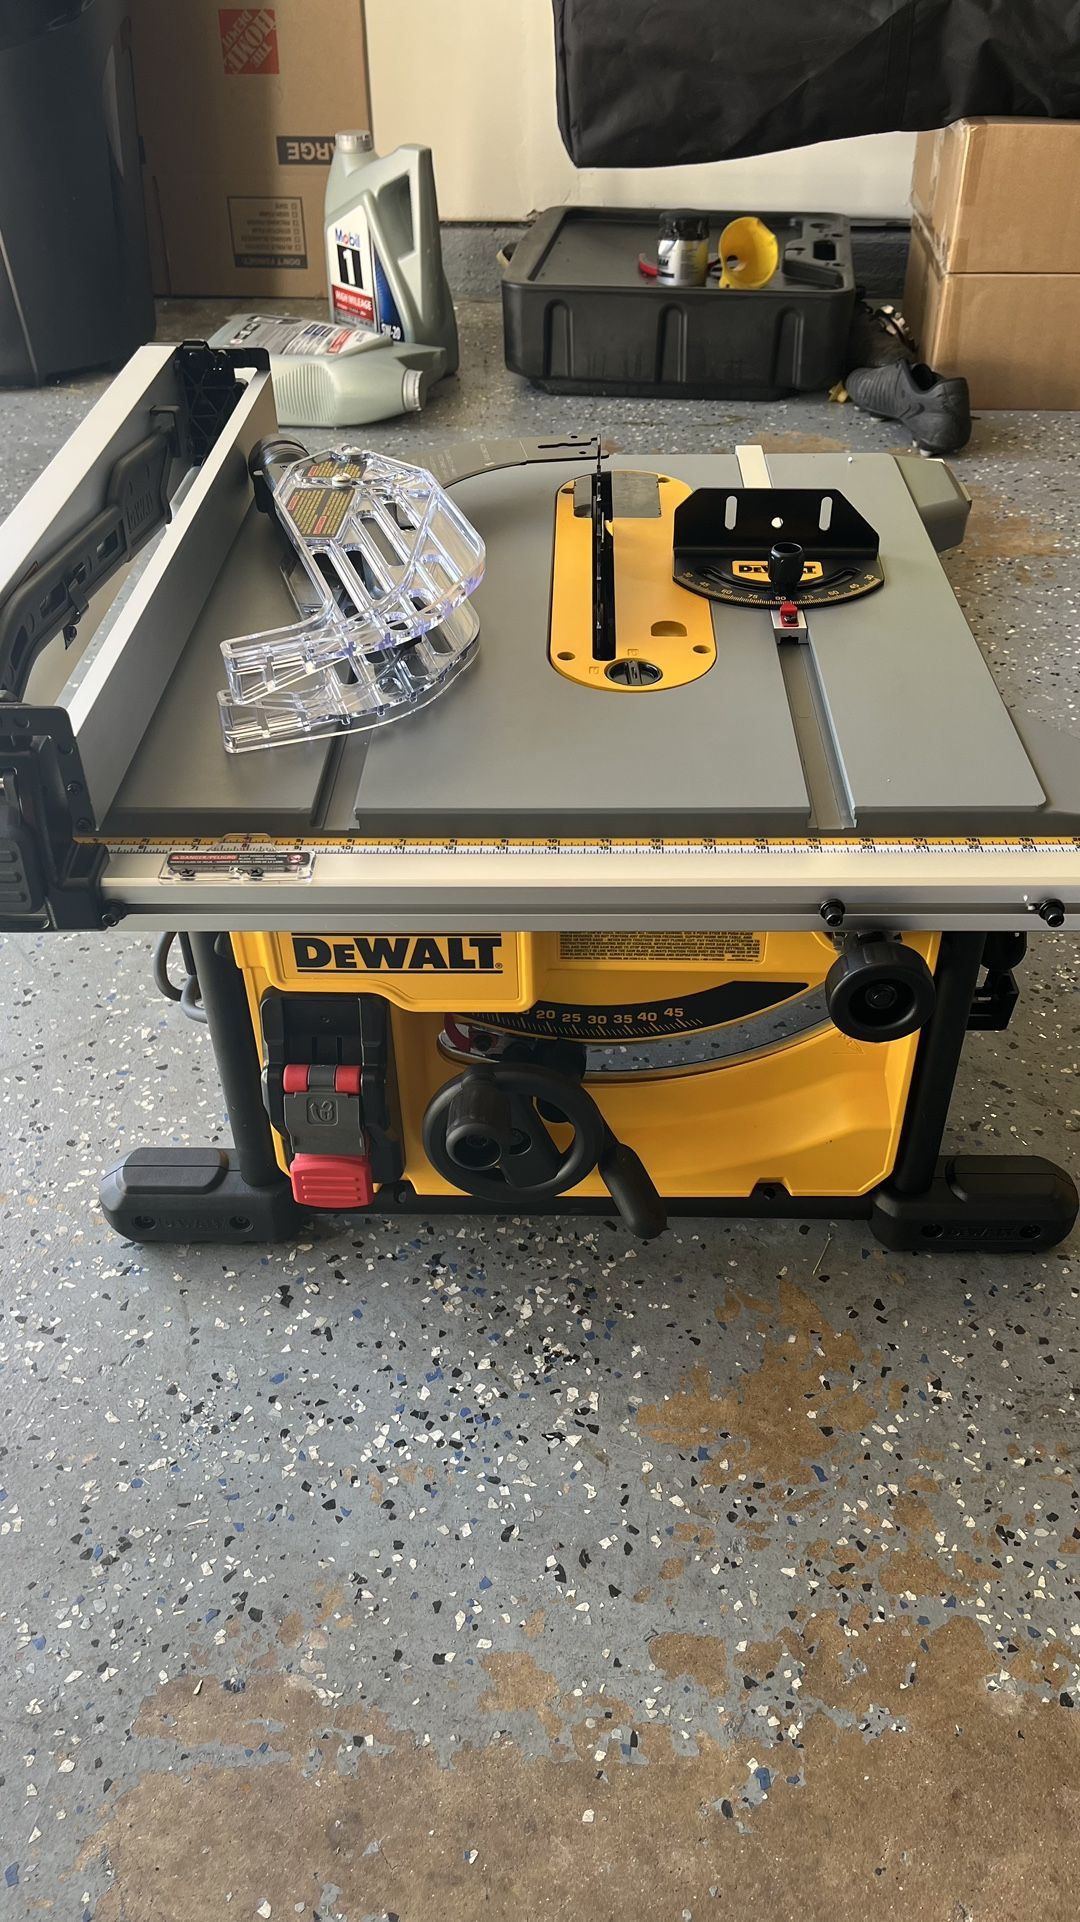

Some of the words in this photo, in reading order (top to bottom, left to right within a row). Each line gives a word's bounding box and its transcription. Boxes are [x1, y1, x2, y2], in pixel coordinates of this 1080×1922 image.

[223, 10, 281, 75] HOME
[286, 141, 336, 161] RGE
[335, 228, 361, 247] Mobil
[343, 249, 357, 286] 1
[738, 564, 816, 574] DET
[292, 937, 502, 969] DEWALT
[536, 1010, 556, 1020] 20
[561, 1013, 581, 1023] 25
[587, 1015, 607, 1025] 30
[613, 1014, 633, 1024] 35
[637, 1012, 657, 1022] 40
[663, 1007, 684, 1017] 45
